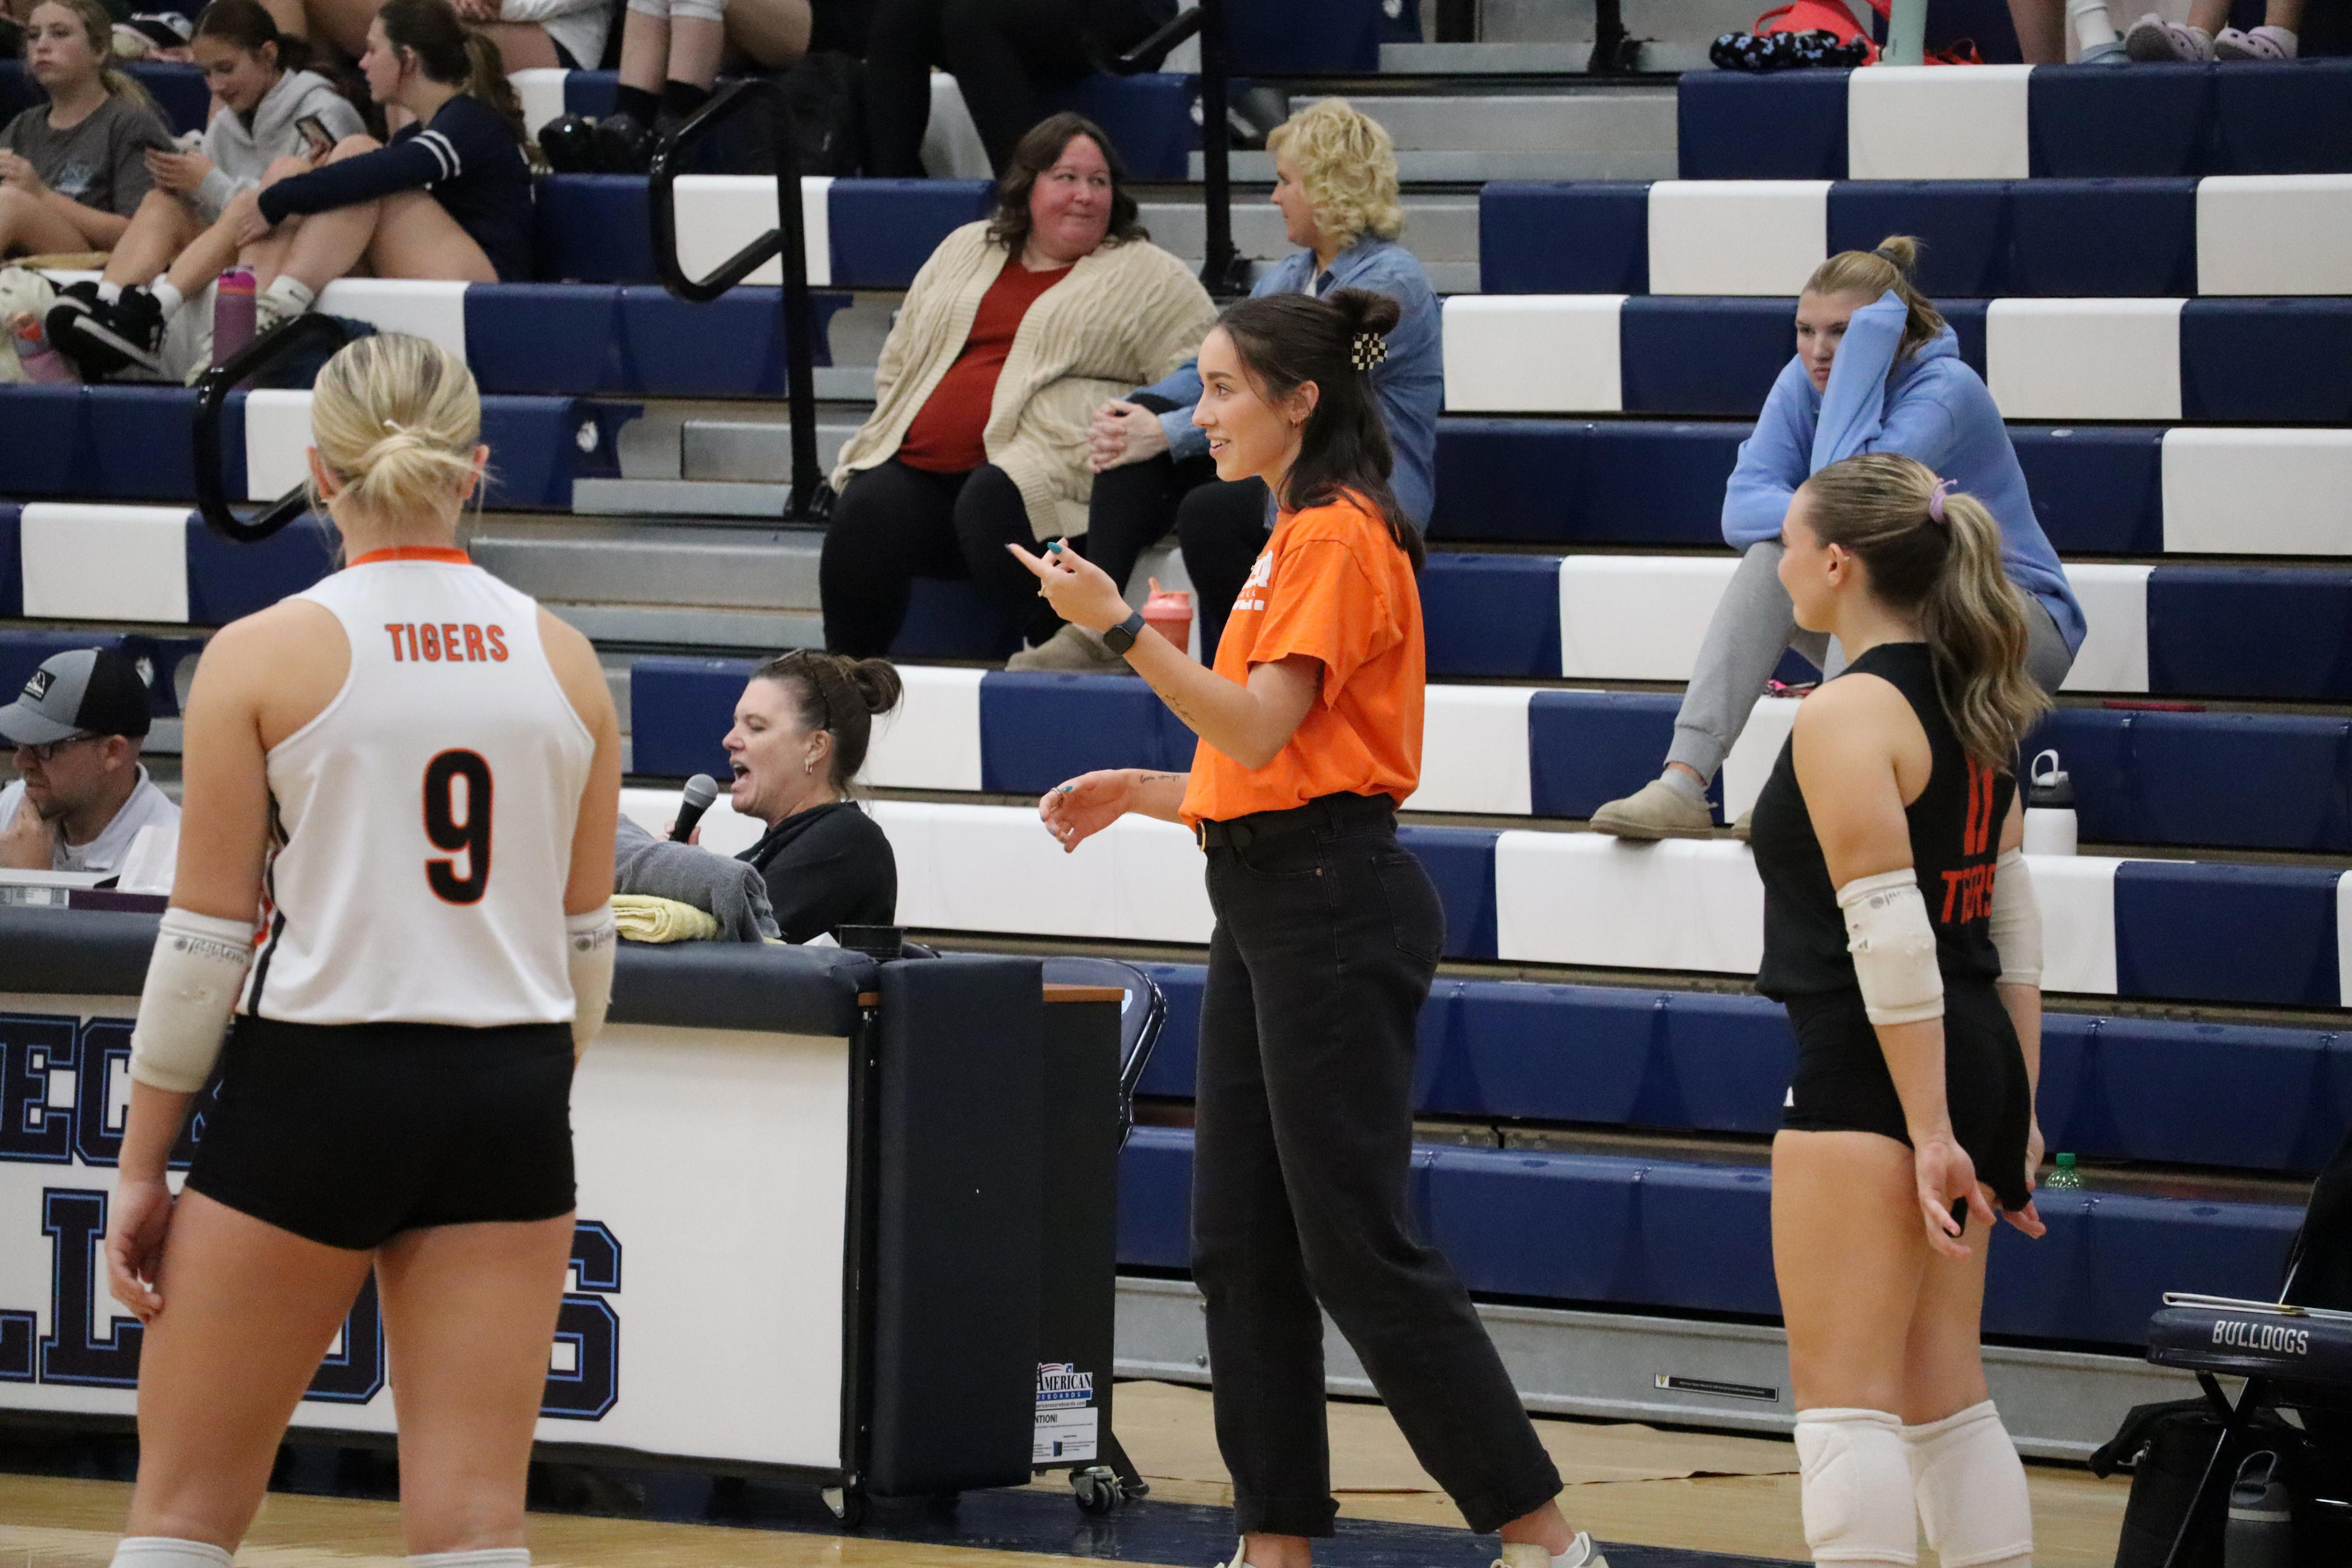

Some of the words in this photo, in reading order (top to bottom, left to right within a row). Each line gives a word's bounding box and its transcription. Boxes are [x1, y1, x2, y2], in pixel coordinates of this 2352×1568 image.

[385, 624, 508, 662] TIGERS
[422, 748, 494, 907] 9
[2212, 1320, 2310, 1355] BULLDOGS
[1036, 1364, 1091, 1391] AMERICAN
